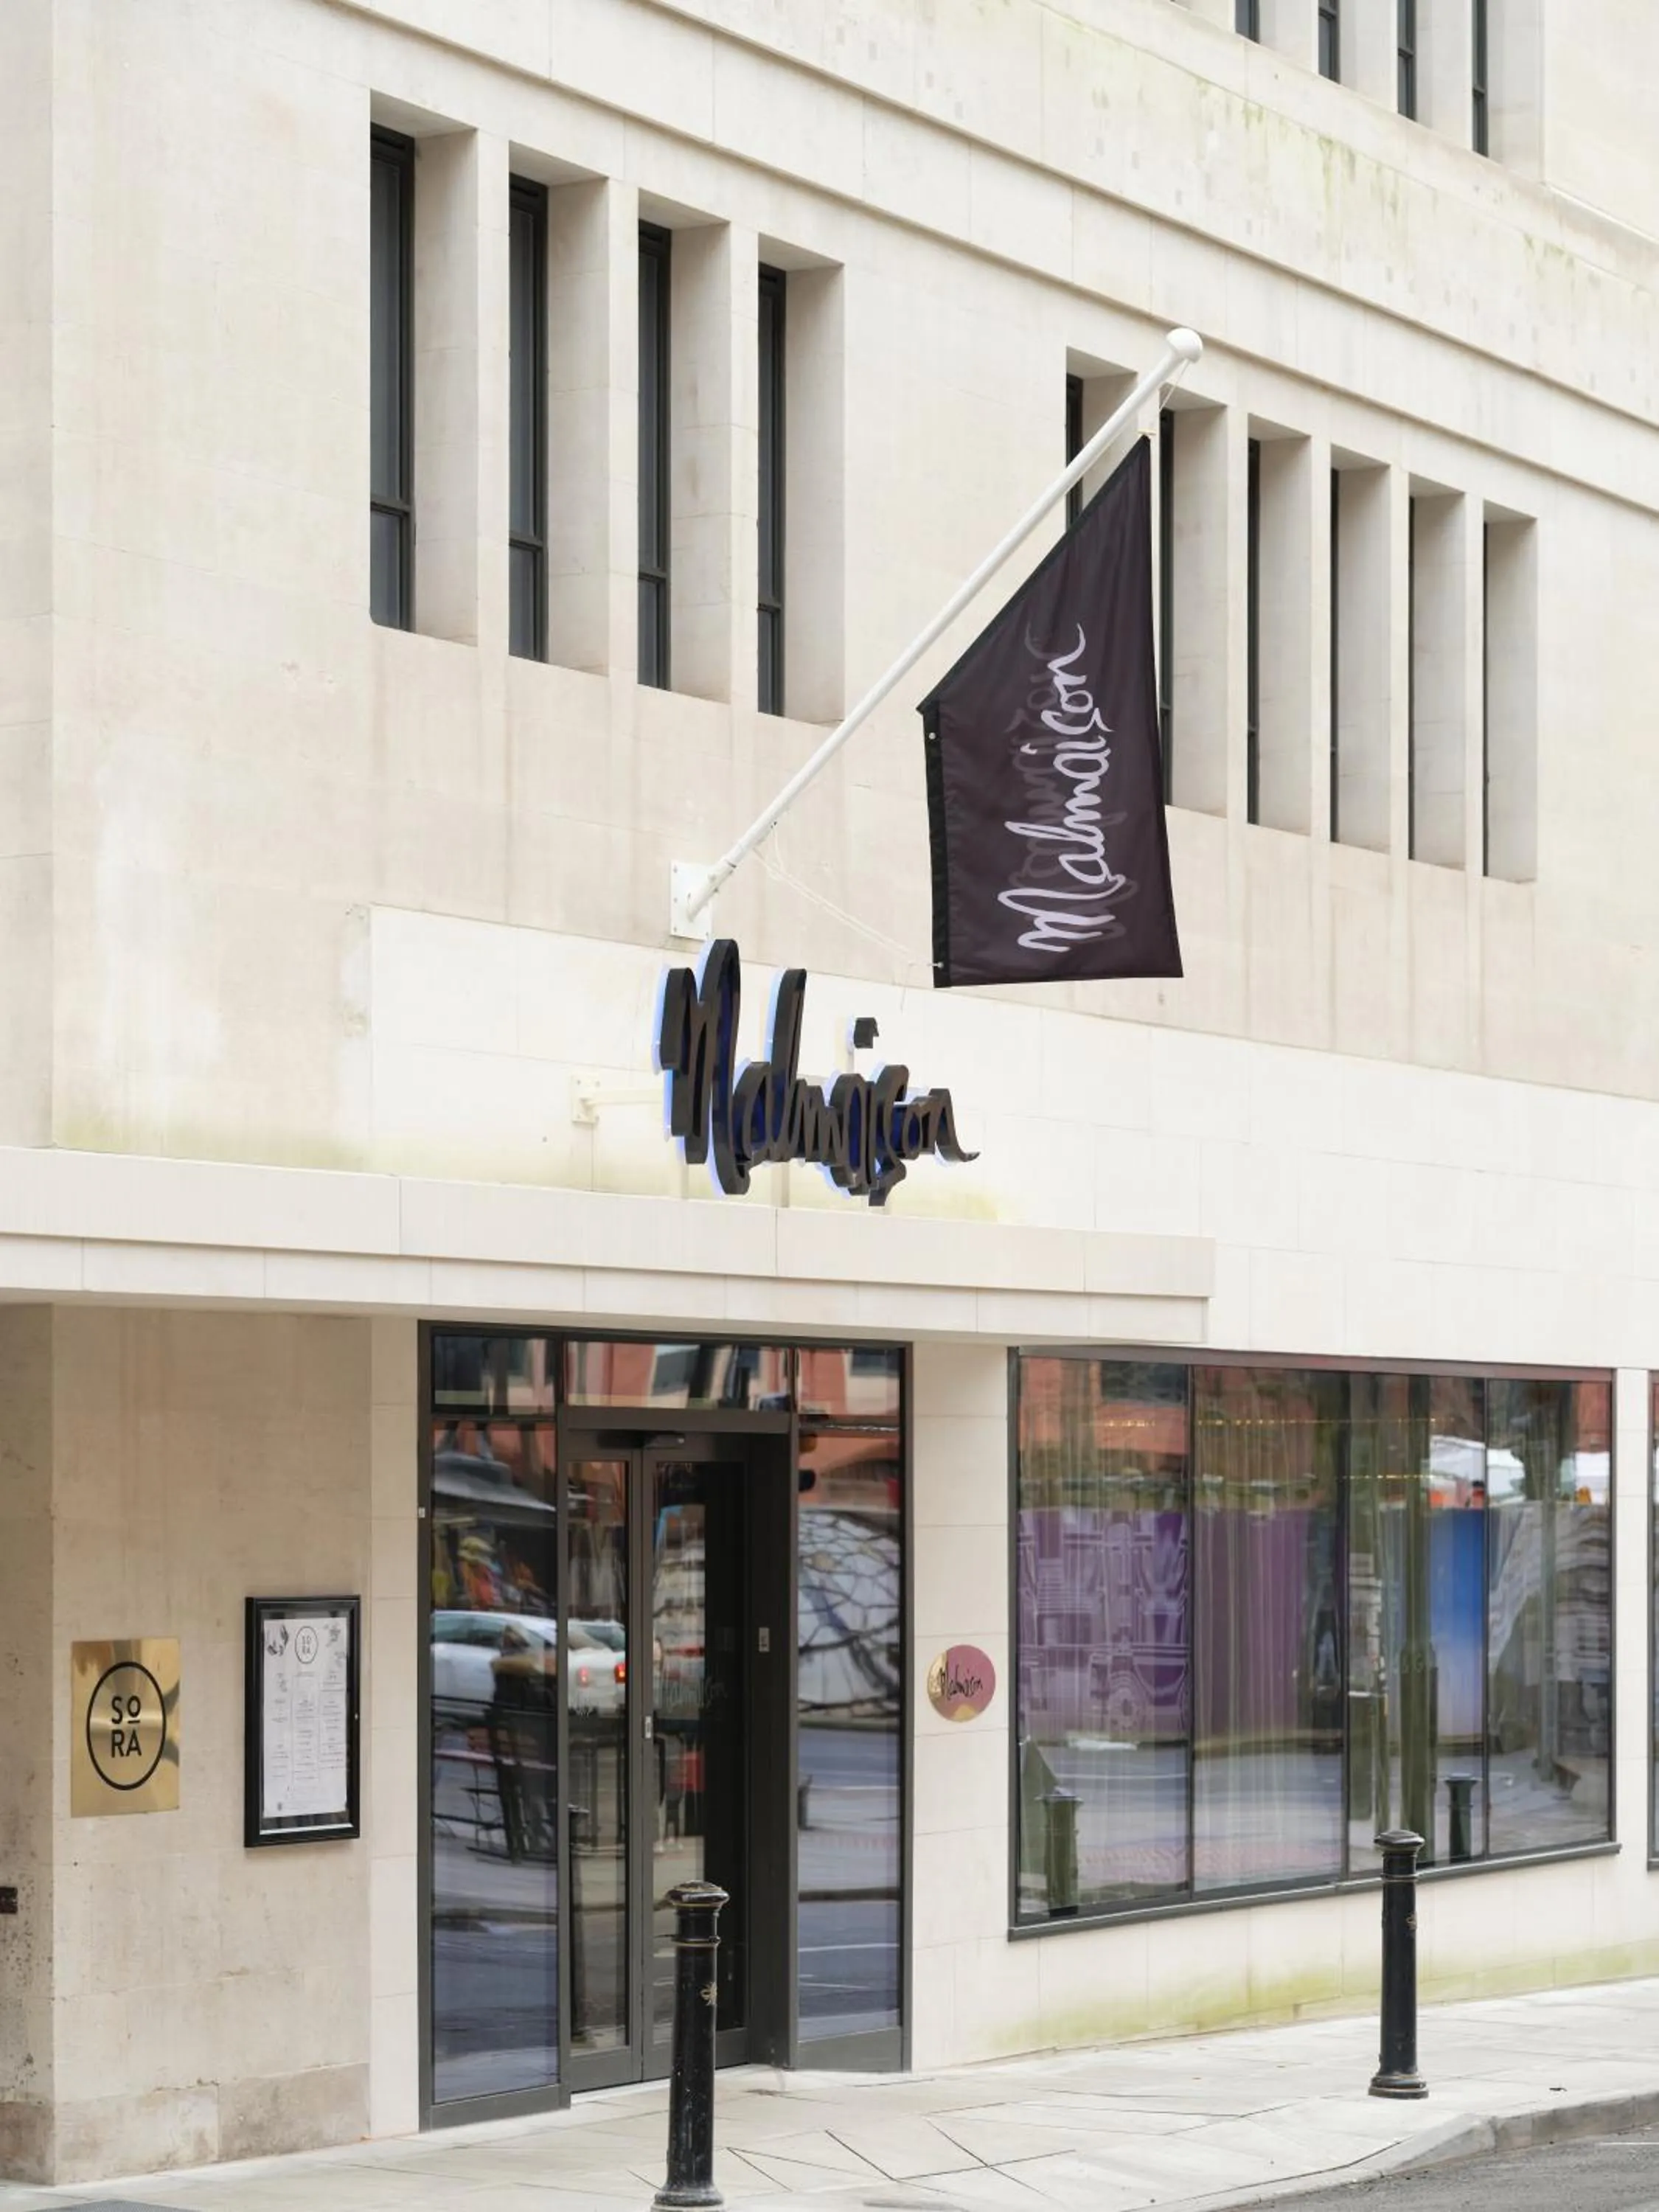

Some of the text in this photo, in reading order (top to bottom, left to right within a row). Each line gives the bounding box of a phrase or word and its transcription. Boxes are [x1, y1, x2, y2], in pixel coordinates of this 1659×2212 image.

[997, 622, 1129, 953] Malmaison
[111, 1695, 142, 1725] SO
[111, 1730, 142, 1758] RA
